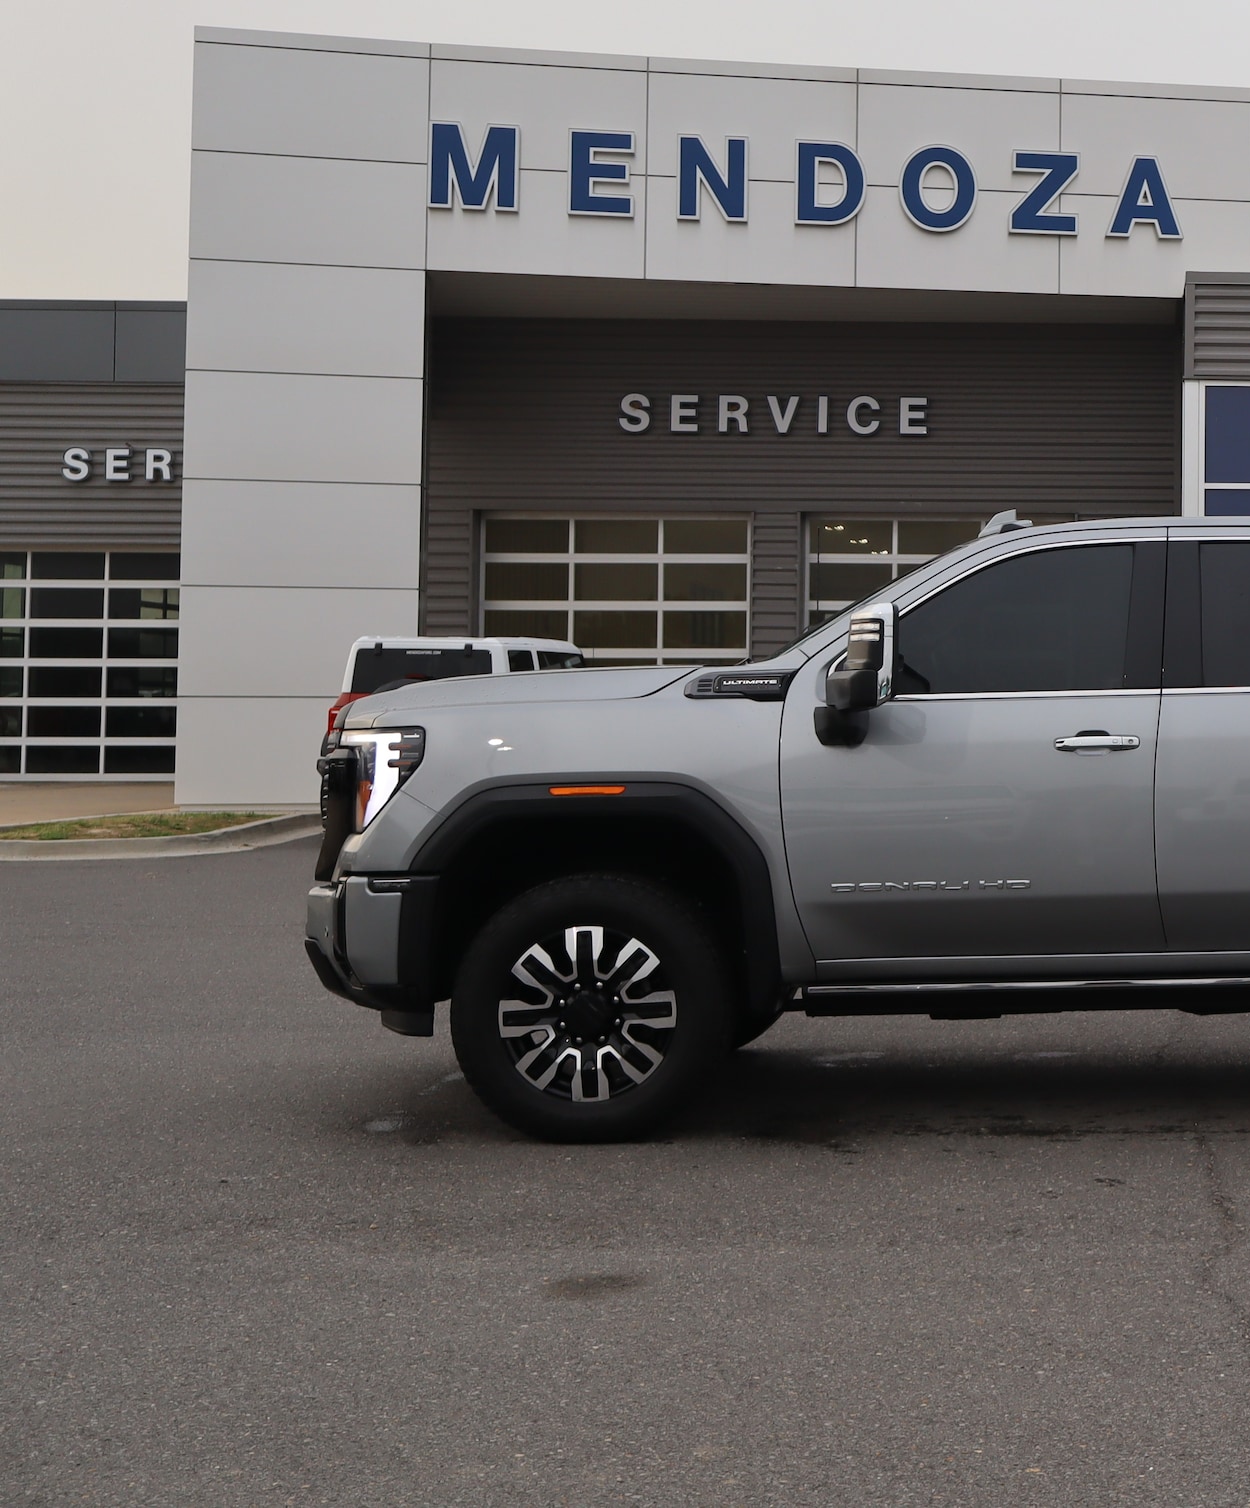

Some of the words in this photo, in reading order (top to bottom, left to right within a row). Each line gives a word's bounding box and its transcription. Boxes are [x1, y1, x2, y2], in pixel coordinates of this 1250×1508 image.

[427, 121, 1183, 240] MENDOZA
[617, 393, 928, 435] SERVICE
[831, 881, 970, 893] DENALI
[978, 879, 1031, 890] HD
